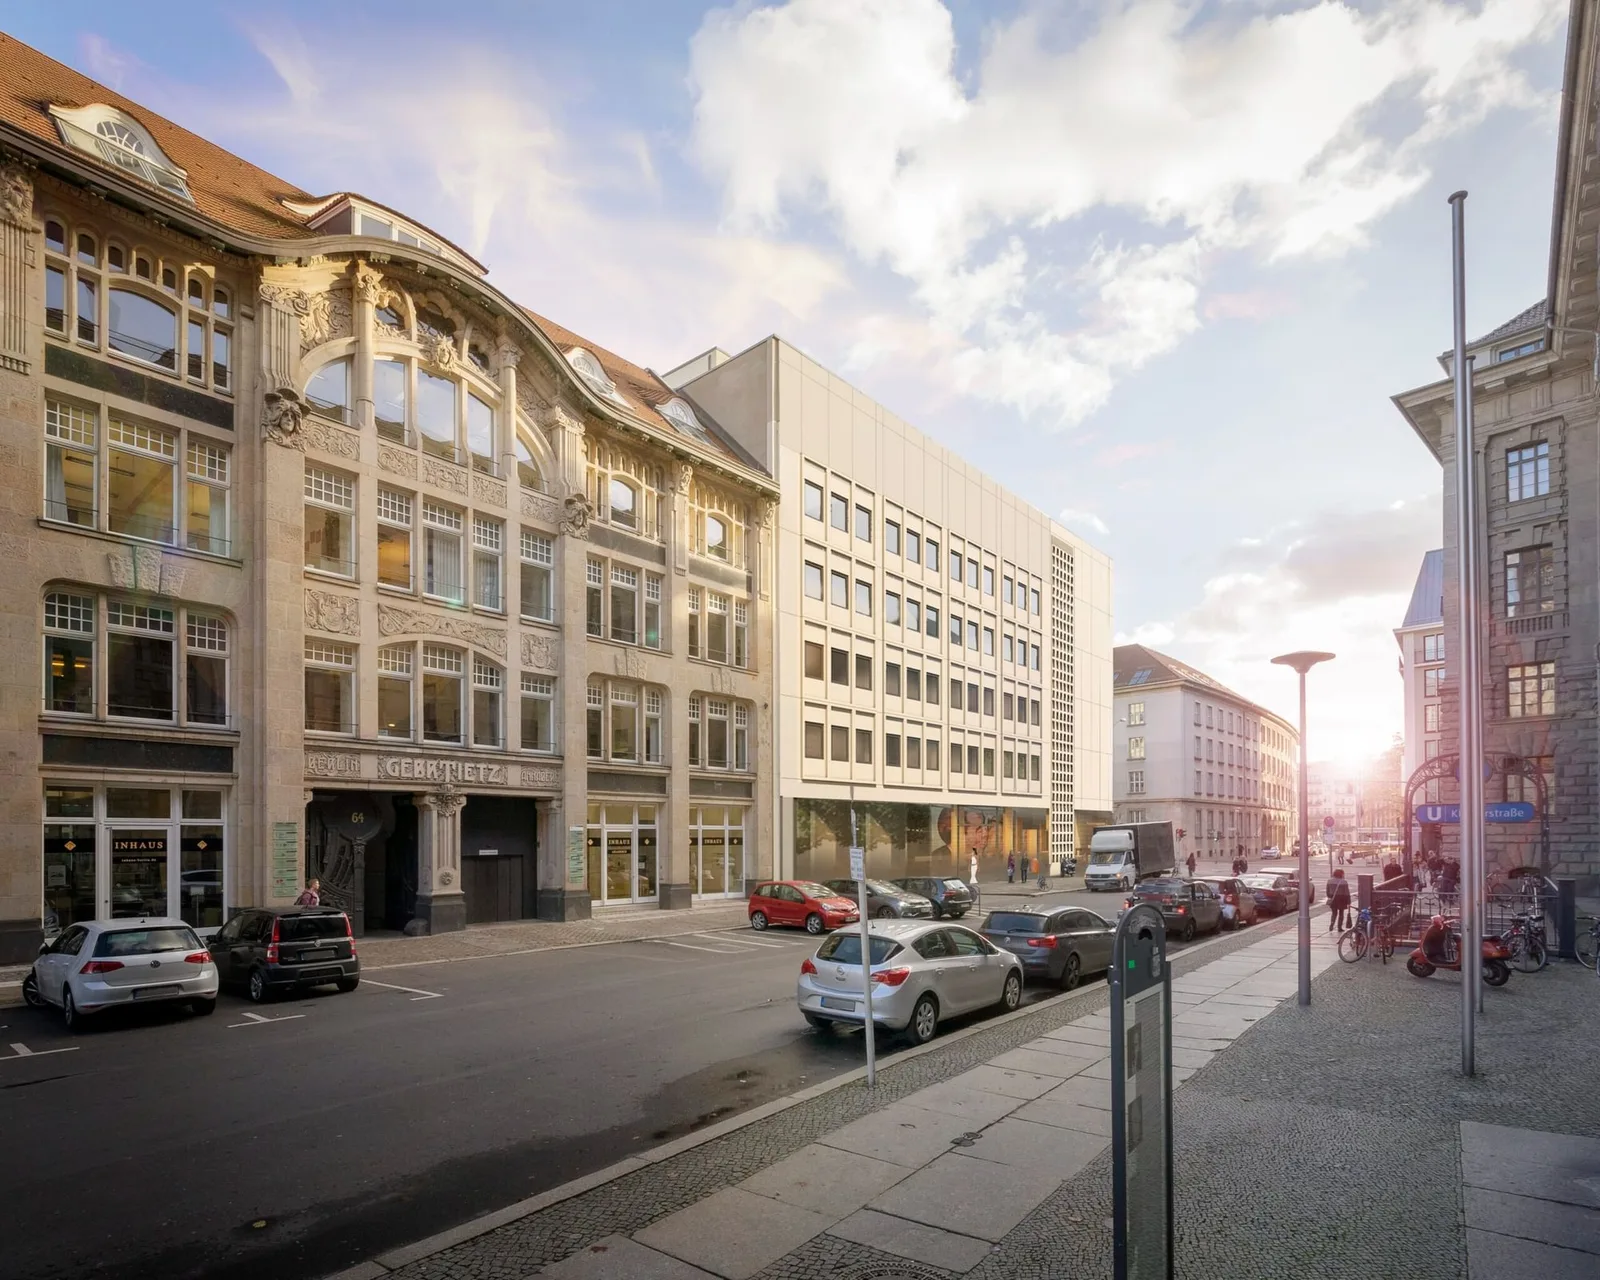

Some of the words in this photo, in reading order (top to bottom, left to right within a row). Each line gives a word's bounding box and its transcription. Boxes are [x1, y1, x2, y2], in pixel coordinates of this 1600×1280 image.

[308, 756, 359, 771] BERLIN
[440, 760, 501, 783] TIETZ
[351, 812, 365, 824] 64
[1427, 806, 1442, 821] U
[1451, 807, 1525, 818] Krstraße
[115, 841, 164, 849] INHAUS
